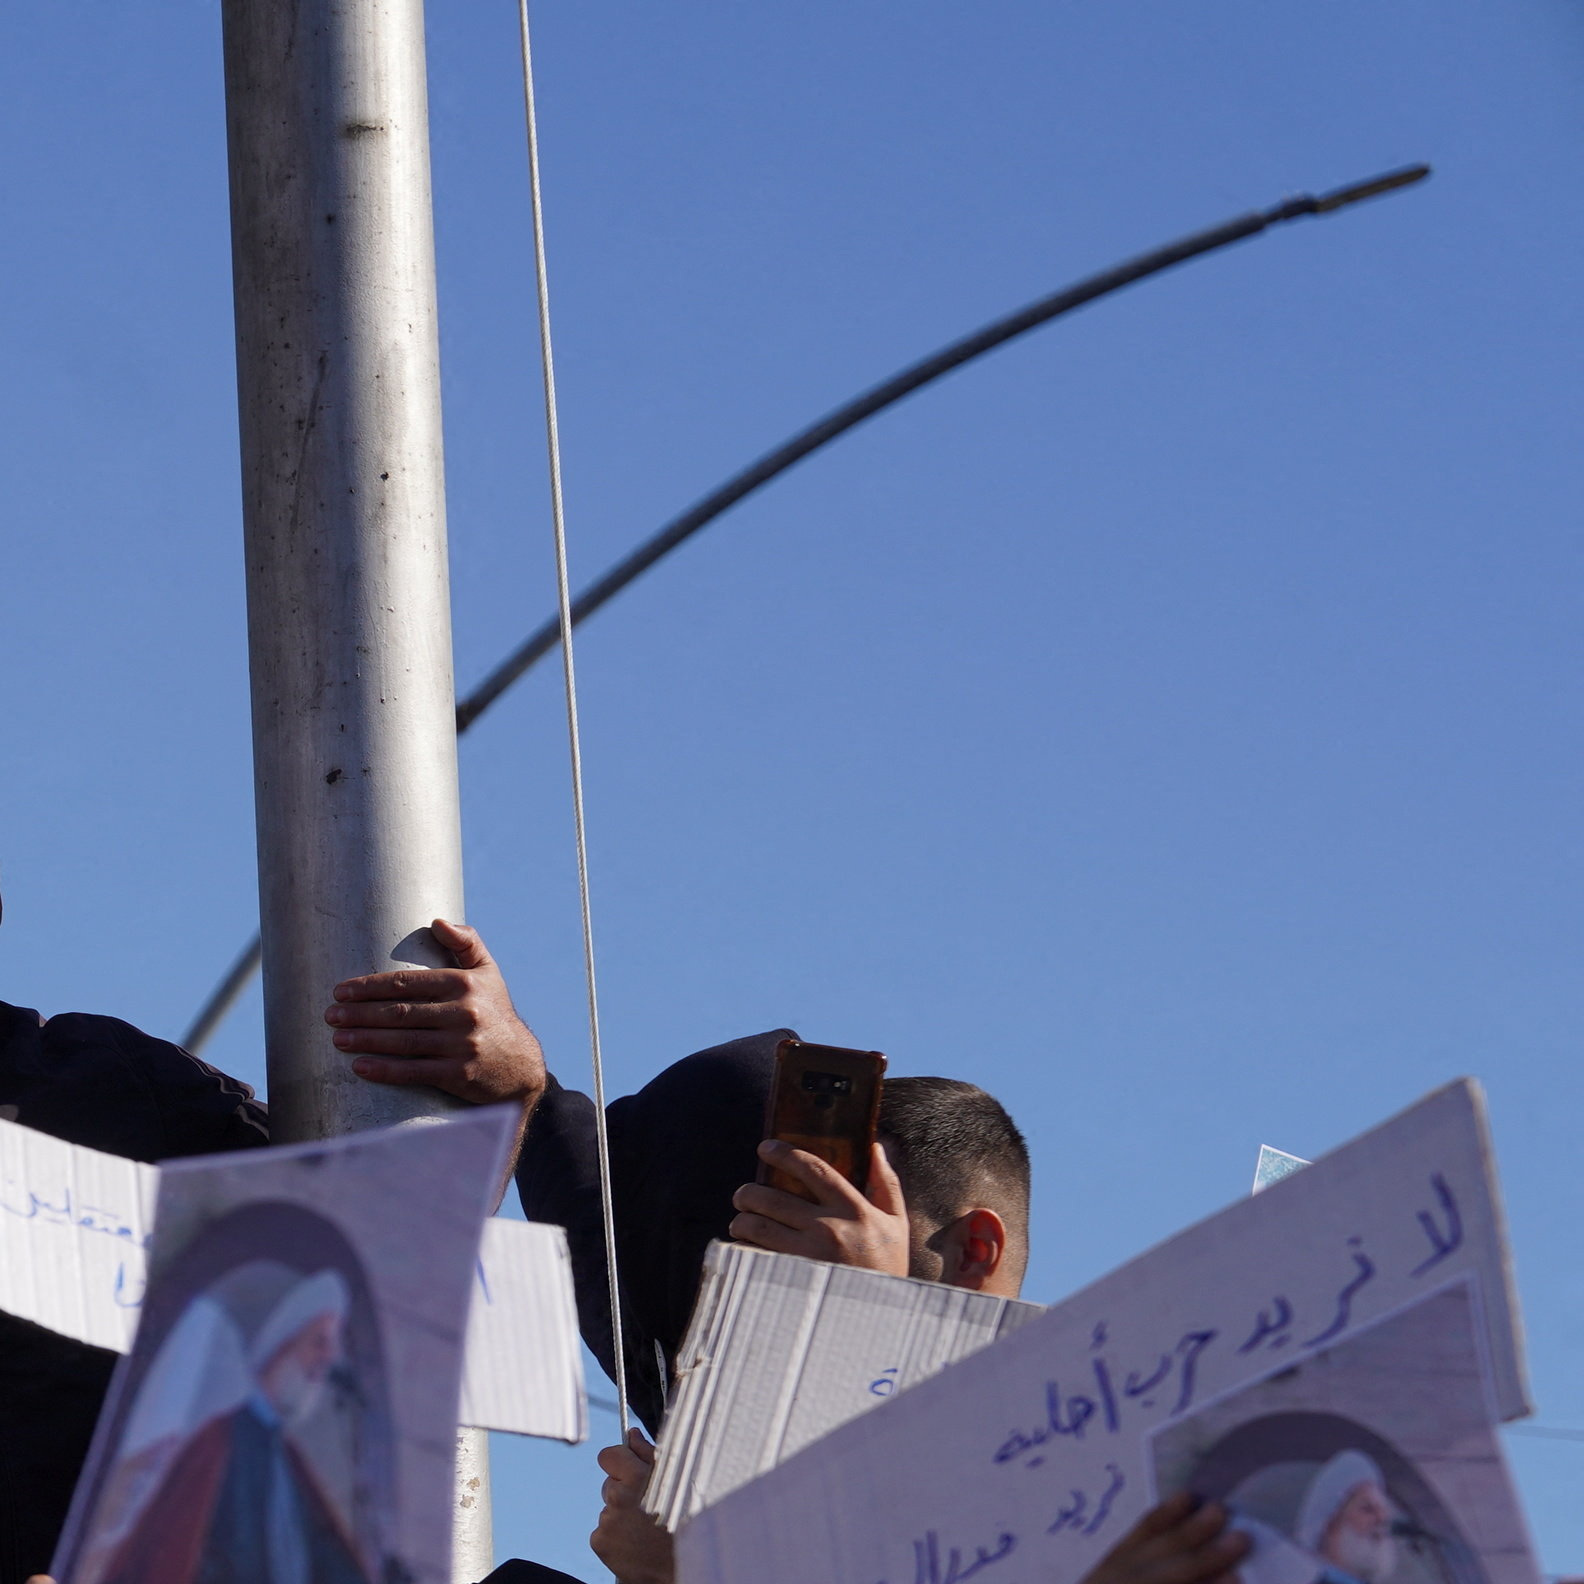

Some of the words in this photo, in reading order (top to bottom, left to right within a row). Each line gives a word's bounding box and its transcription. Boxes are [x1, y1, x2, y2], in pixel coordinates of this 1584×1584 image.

[1409, 1170, 1464, 1279] لا
[1235, 1234, 1376, 1355] نريد
[1122, 1325, 1219, 1420] حرب
[1045, 1461, 1126, 1536] نريد
